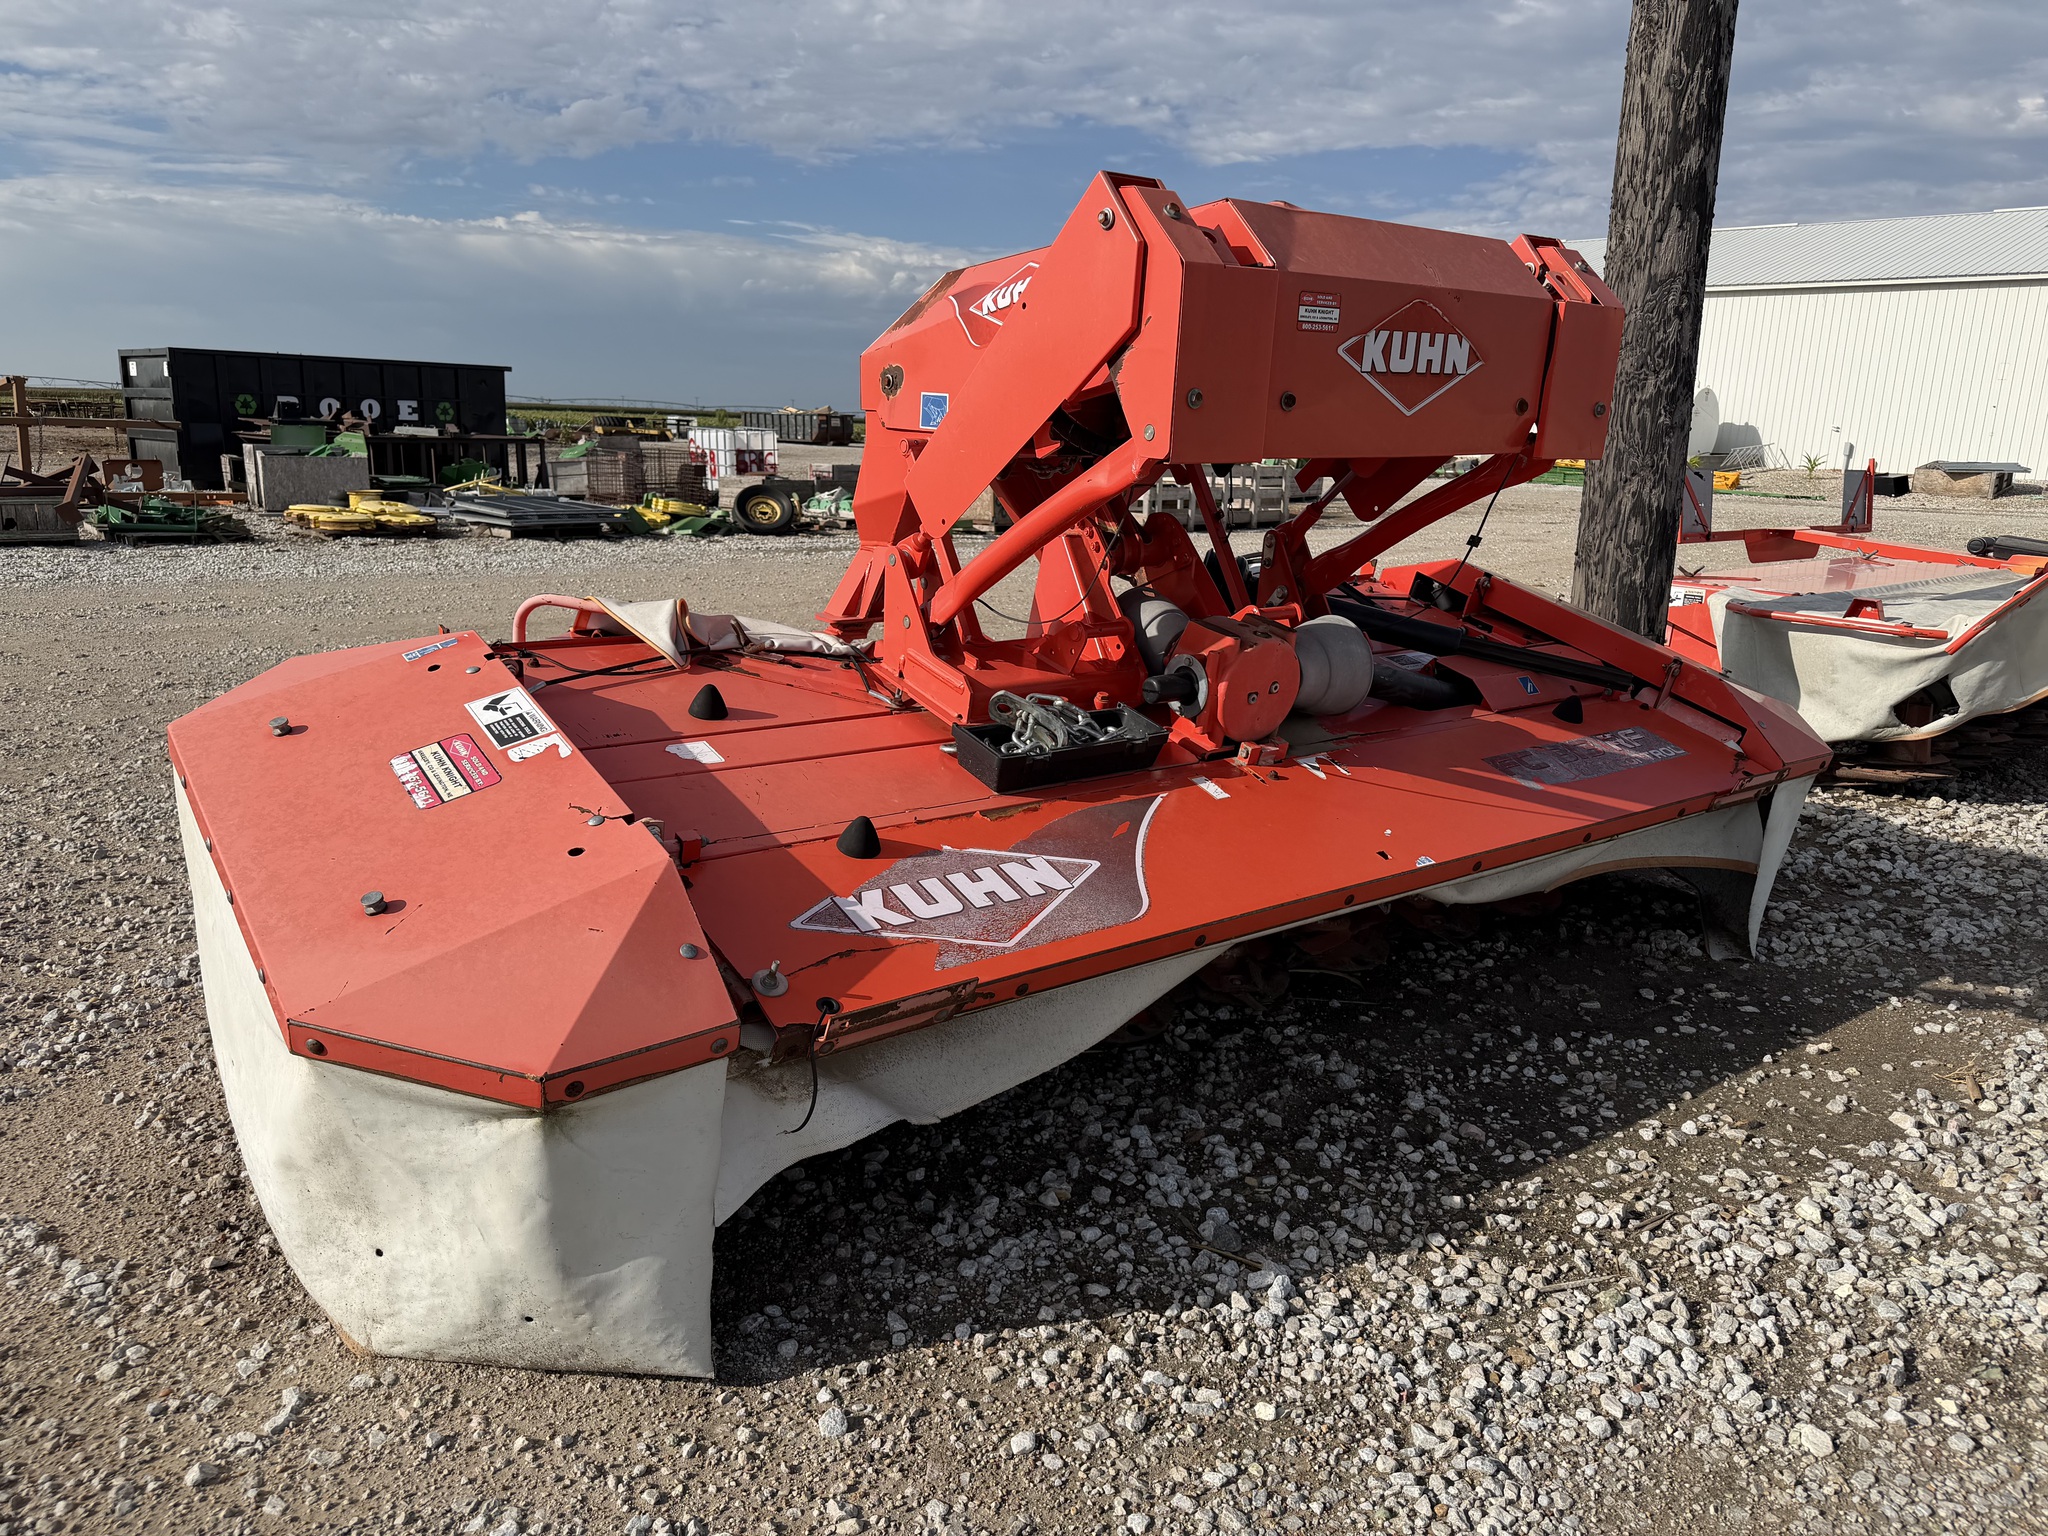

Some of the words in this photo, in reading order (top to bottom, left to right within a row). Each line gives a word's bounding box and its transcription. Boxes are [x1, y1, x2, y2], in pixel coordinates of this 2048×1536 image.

[1361, 330, 1470, 374] KUHN
[530, 713, 548, 733] WARNING
[453, 740, 468, 757] KUHN
[431, 750, 444, 768] KUHN
[442, 767, 462, 788] KNIGHT
[832, 856, 1074, 932] KUHN
